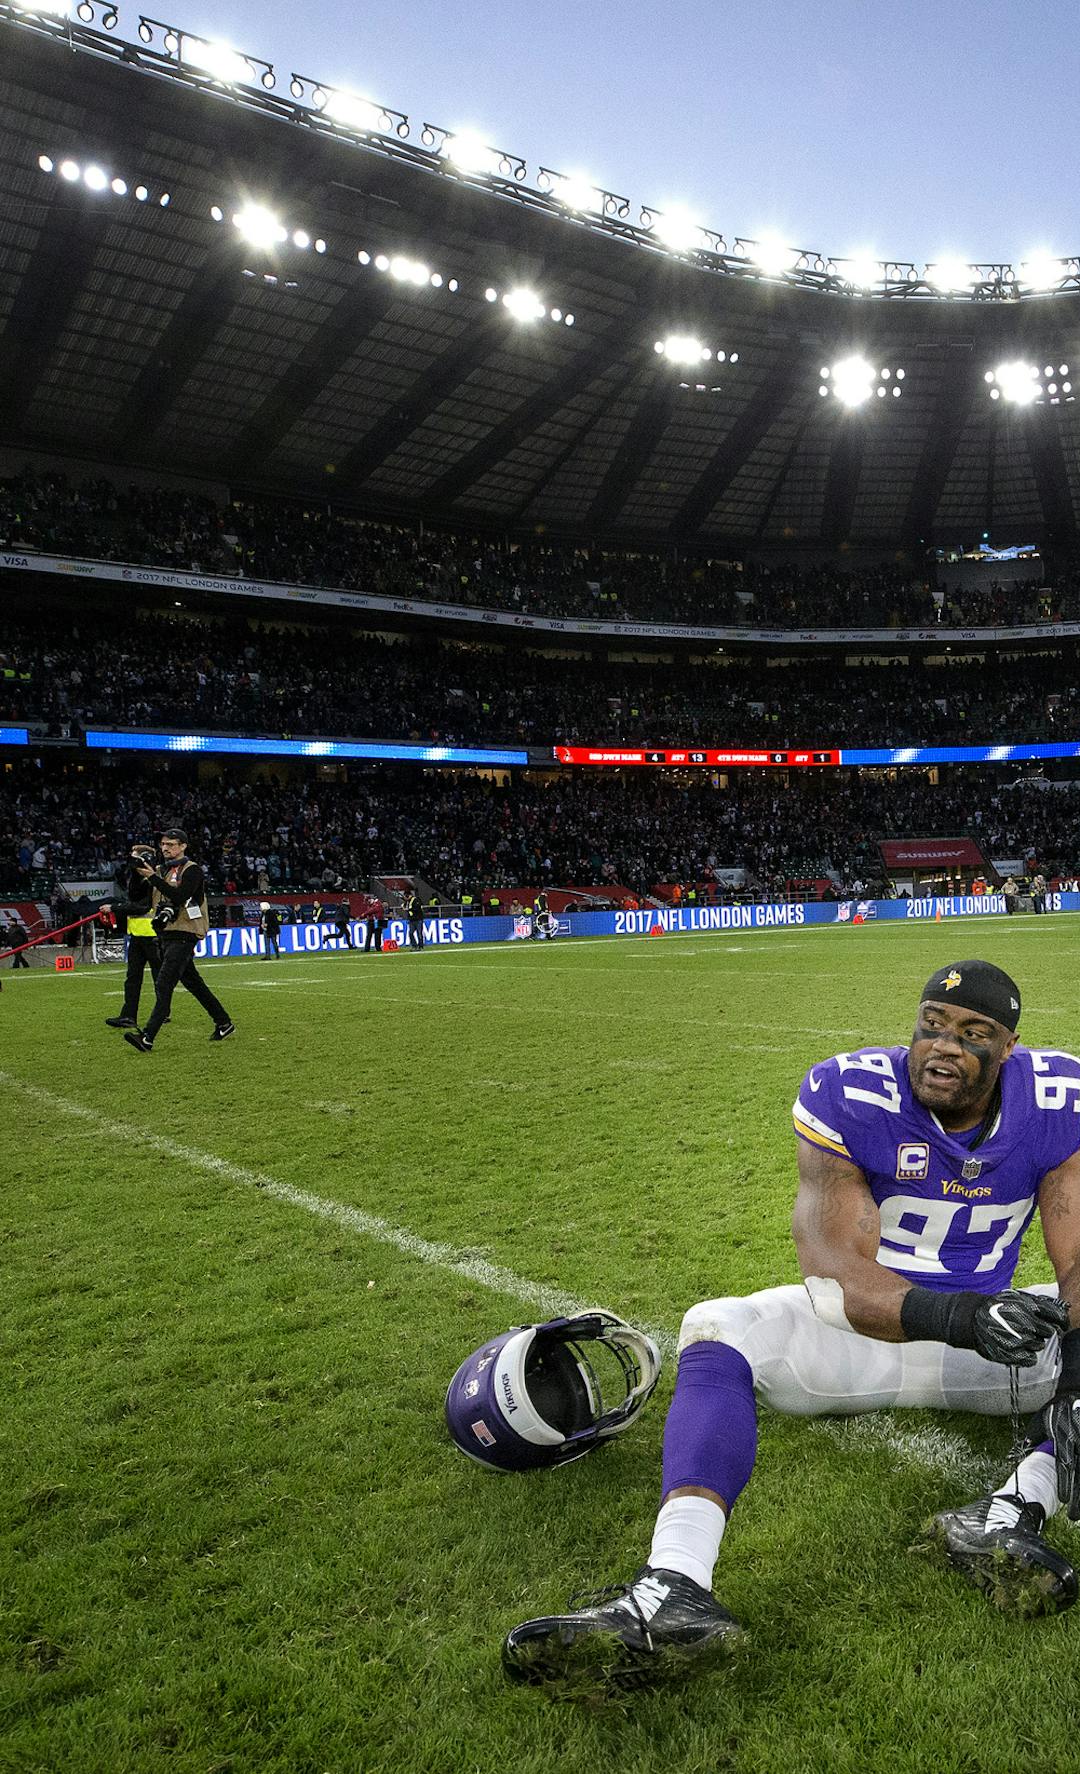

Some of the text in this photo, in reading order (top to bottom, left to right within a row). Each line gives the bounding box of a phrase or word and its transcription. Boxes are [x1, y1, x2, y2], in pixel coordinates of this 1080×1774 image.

[3, 556, 28, 566] VISA
[137, 573, 264, 593] 2017 NFL LONDON GAMES
[549, 621, 565, 630] VISA
[691, 752, 704, 763] 13
[906, 895, 1006, 918] 2017 NFL LONDON
[615, 911, 653, 934] 2017
[658, 908, 687, 932] NFL
[691, 906, 752, 930] LONDON
[758, 903, 805, 926] GAMES
[836, 1052, 902, 1113] 97
[901, 1146, 927, 1170] C
[876, 1193, 1035, 1273] 97
